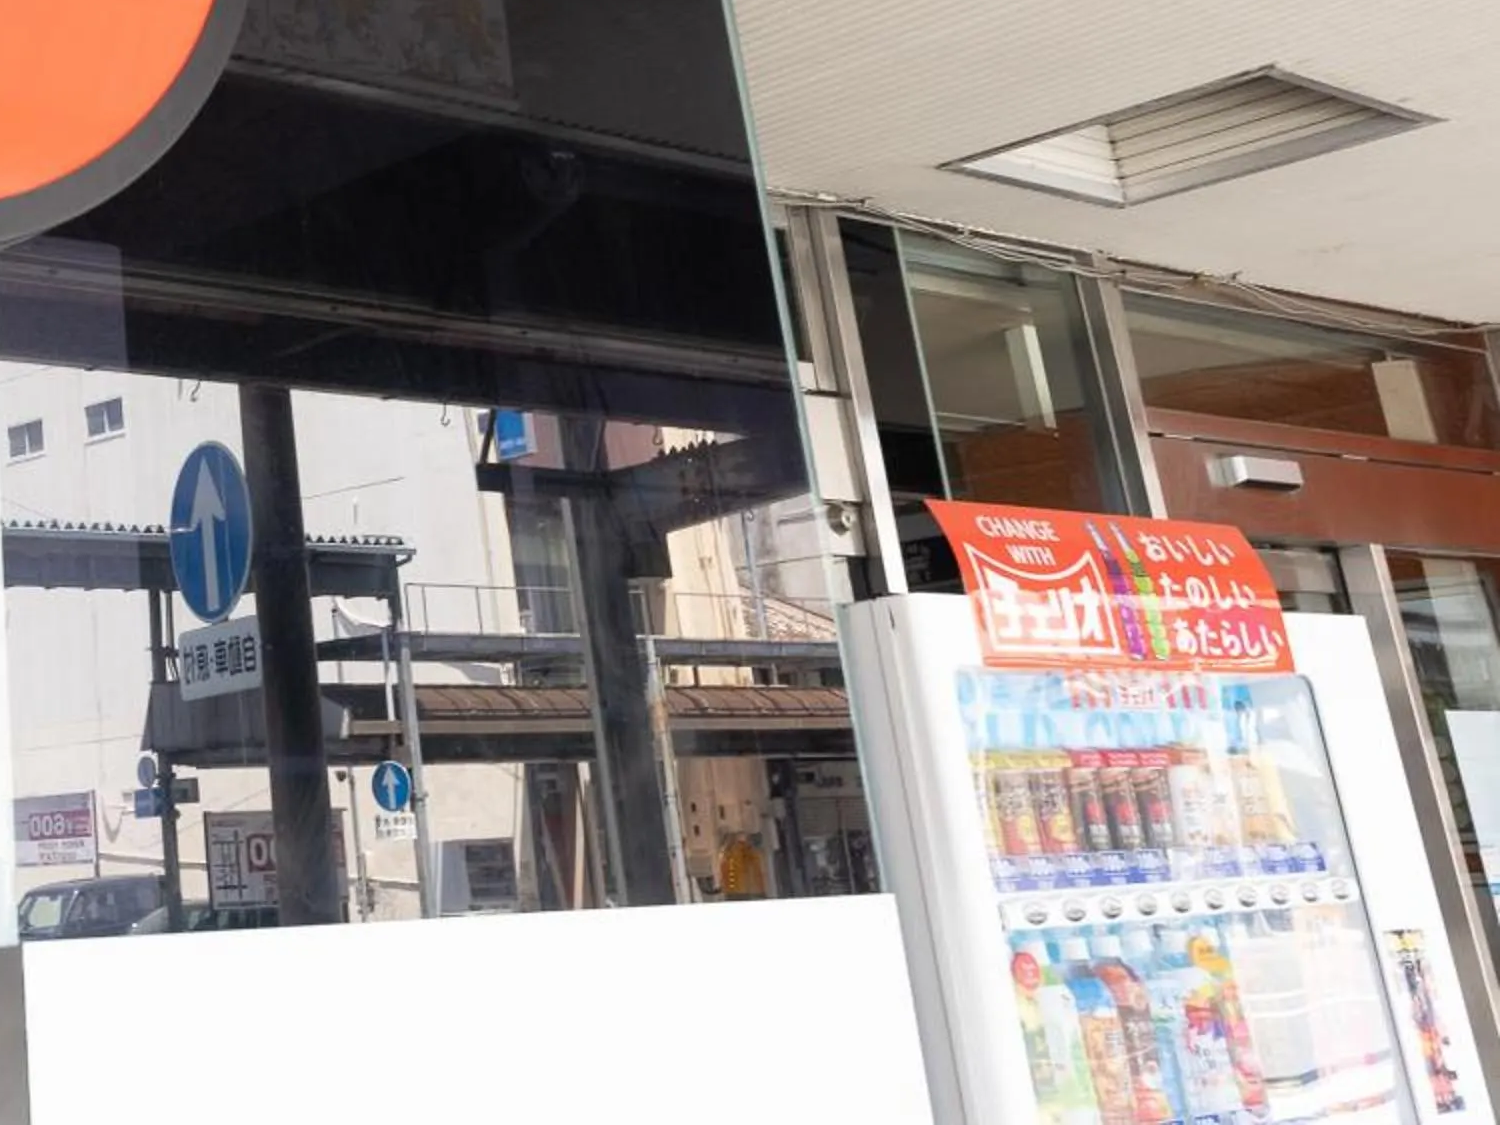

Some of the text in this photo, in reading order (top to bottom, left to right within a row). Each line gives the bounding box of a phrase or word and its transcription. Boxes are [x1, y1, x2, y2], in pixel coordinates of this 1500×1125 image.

[975, 515, 1060, 543] CHANGE
[1007, 544, 1055, 566] WITH
[1139, 531, 1234, 565] おいしい
[984, 566, 1104, 642] チェリオ
[1157, 572, 1256, 610] たのしい
[1171, 618, 1284, 657] あたらしい
